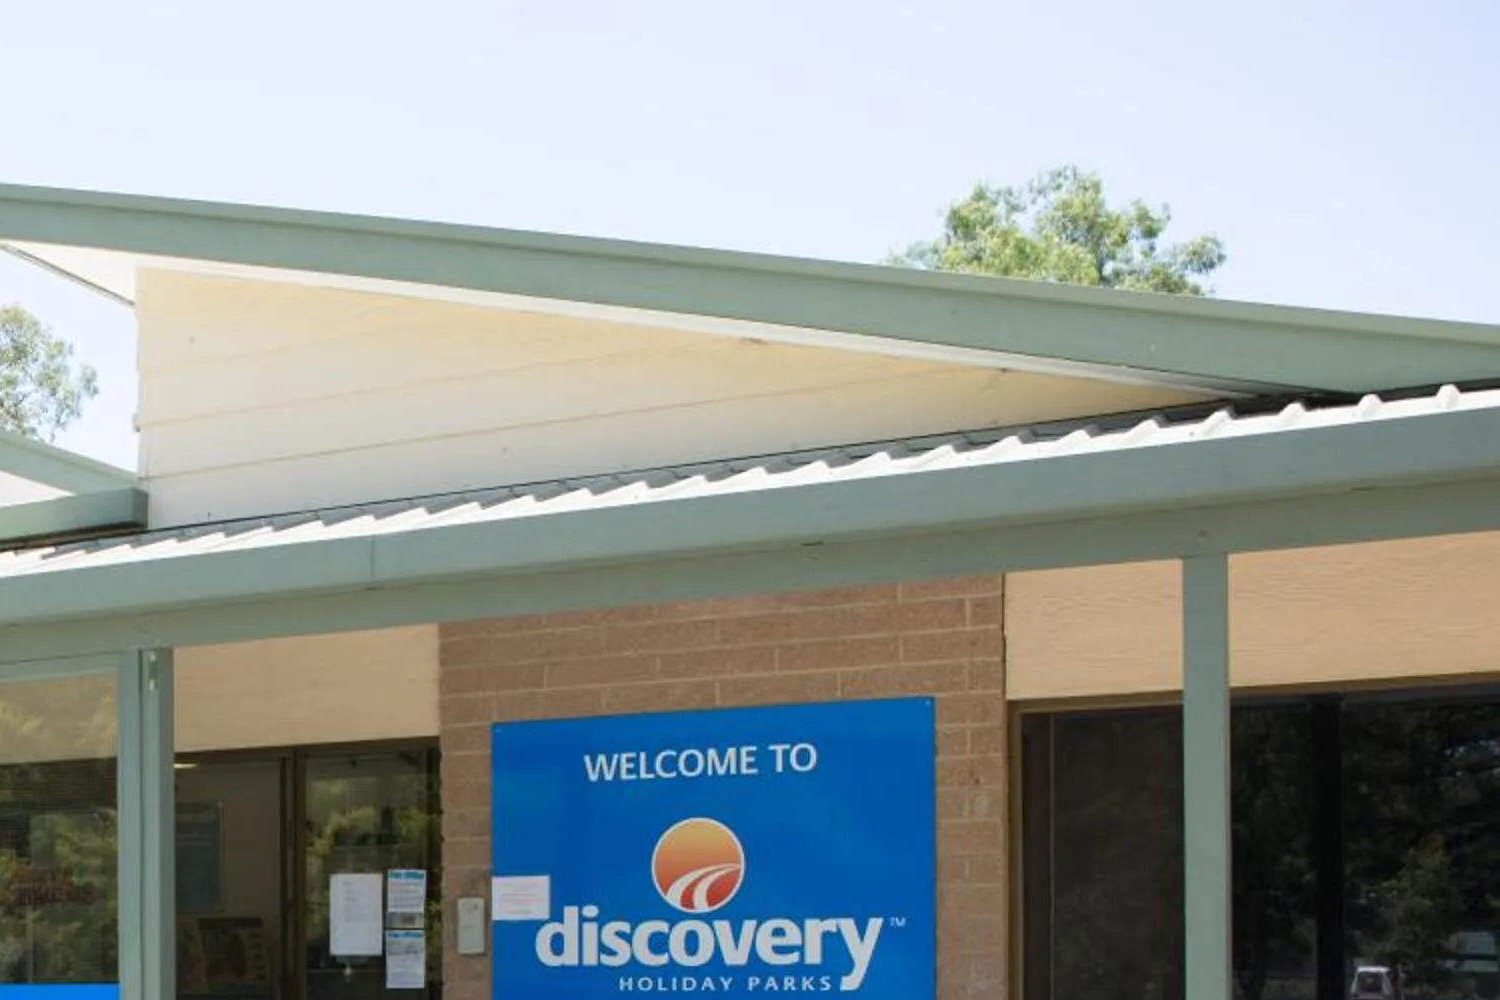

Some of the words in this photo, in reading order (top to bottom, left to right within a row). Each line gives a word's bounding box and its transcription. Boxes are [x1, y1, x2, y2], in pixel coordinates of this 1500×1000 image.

[583, 745, 759, 783] WELCOME
[768, 742, 818, 774] TO
[535, 904, 884, 991] discovery
[619, 976, 734, 992] HOLIDAY
[747, 975, 832, 991] PARKS
